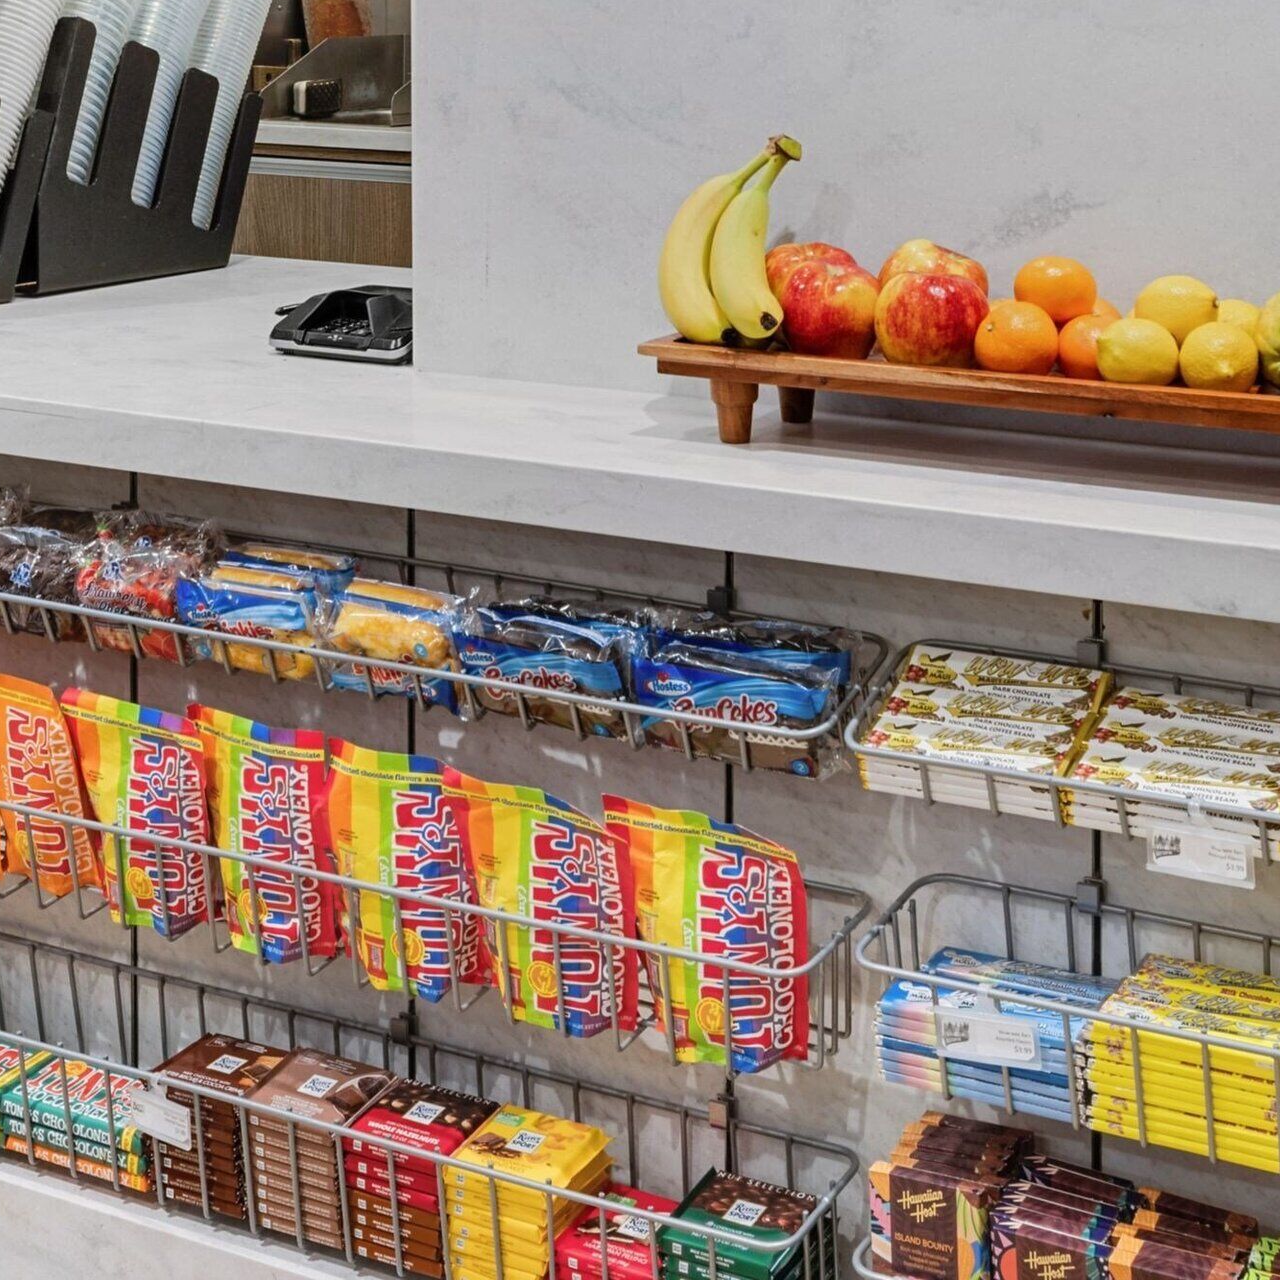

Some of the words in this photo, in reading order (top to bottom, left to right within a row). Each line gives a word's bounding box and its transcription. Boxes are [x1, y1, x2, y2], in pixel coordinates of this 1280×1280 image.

[649, 678, 692, 695] Hostess
[633, 819, 663, 831] assorted
[718, 1170, 742, 1181] NUT
[746, 1177, 816, 1201] SELECTION
[897, 1189, 946, 1207] Hawaiian
[729, 1210, 756, 1226] SPORT
[910, 1202, 946, 1223] Host
[895, 1233, 921, 1247] ISLAND
[922, 1239, 954, 1253] BOUNTY
